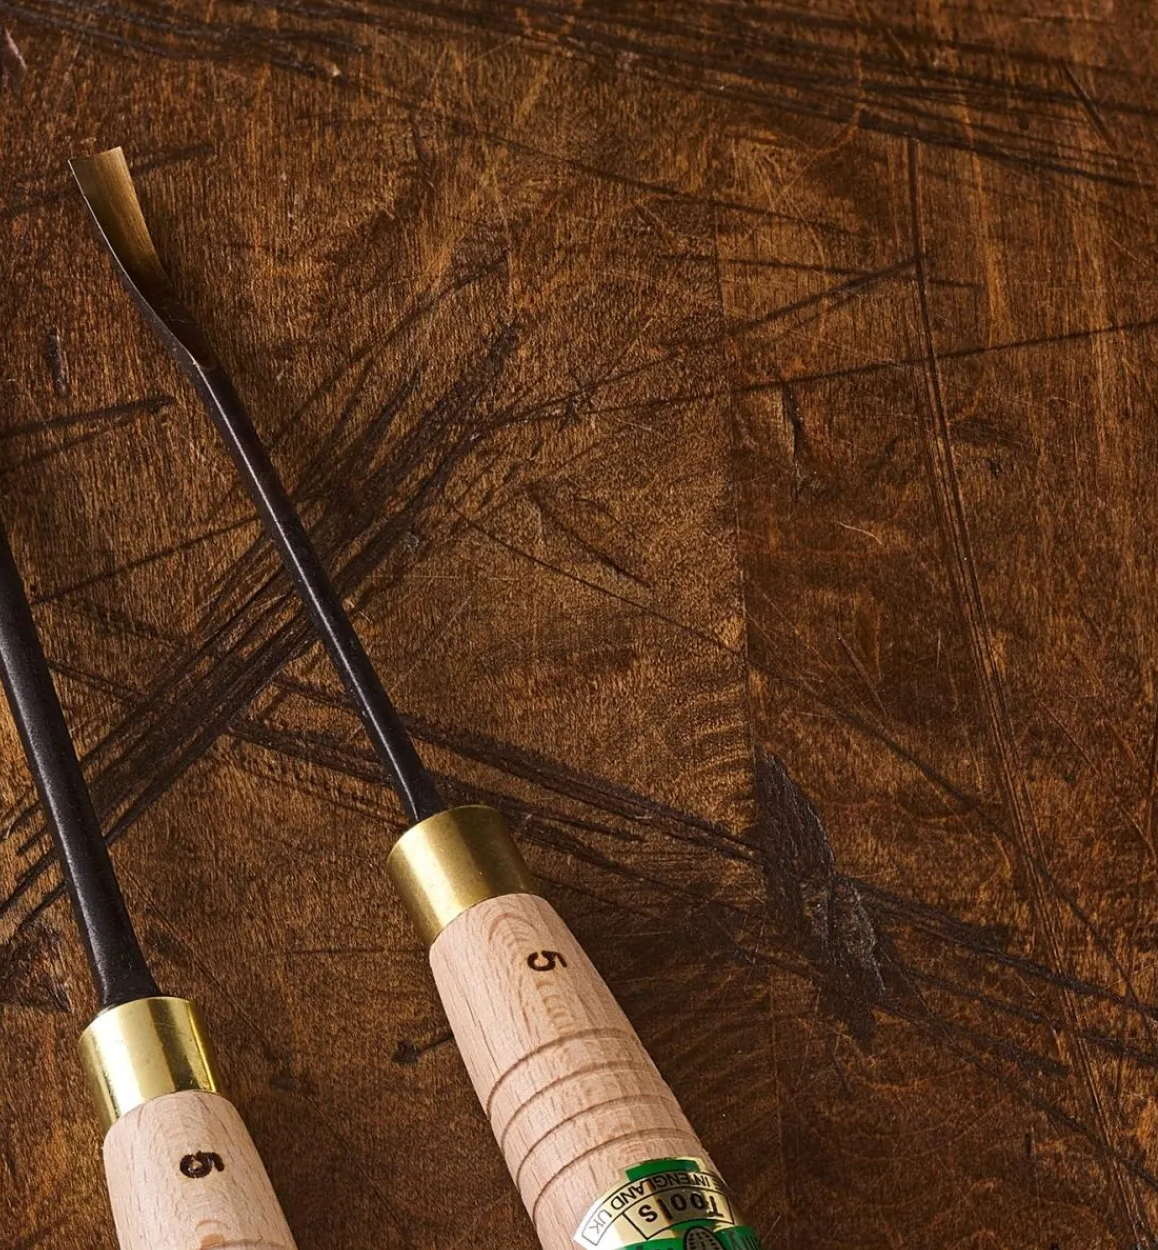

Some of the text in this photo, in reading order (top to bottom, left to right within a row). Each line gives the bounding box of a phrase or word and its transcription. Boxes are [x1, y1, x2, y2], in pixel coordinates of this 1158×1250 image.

[527, 950, 567, 971] 5
[179, 1150, 225, 1178] 5
[610, 1172, 697, 1210] ENGLAND
[638, 1192, 724, 1223] Tools
[589, 1210, 613, 1236] UK
